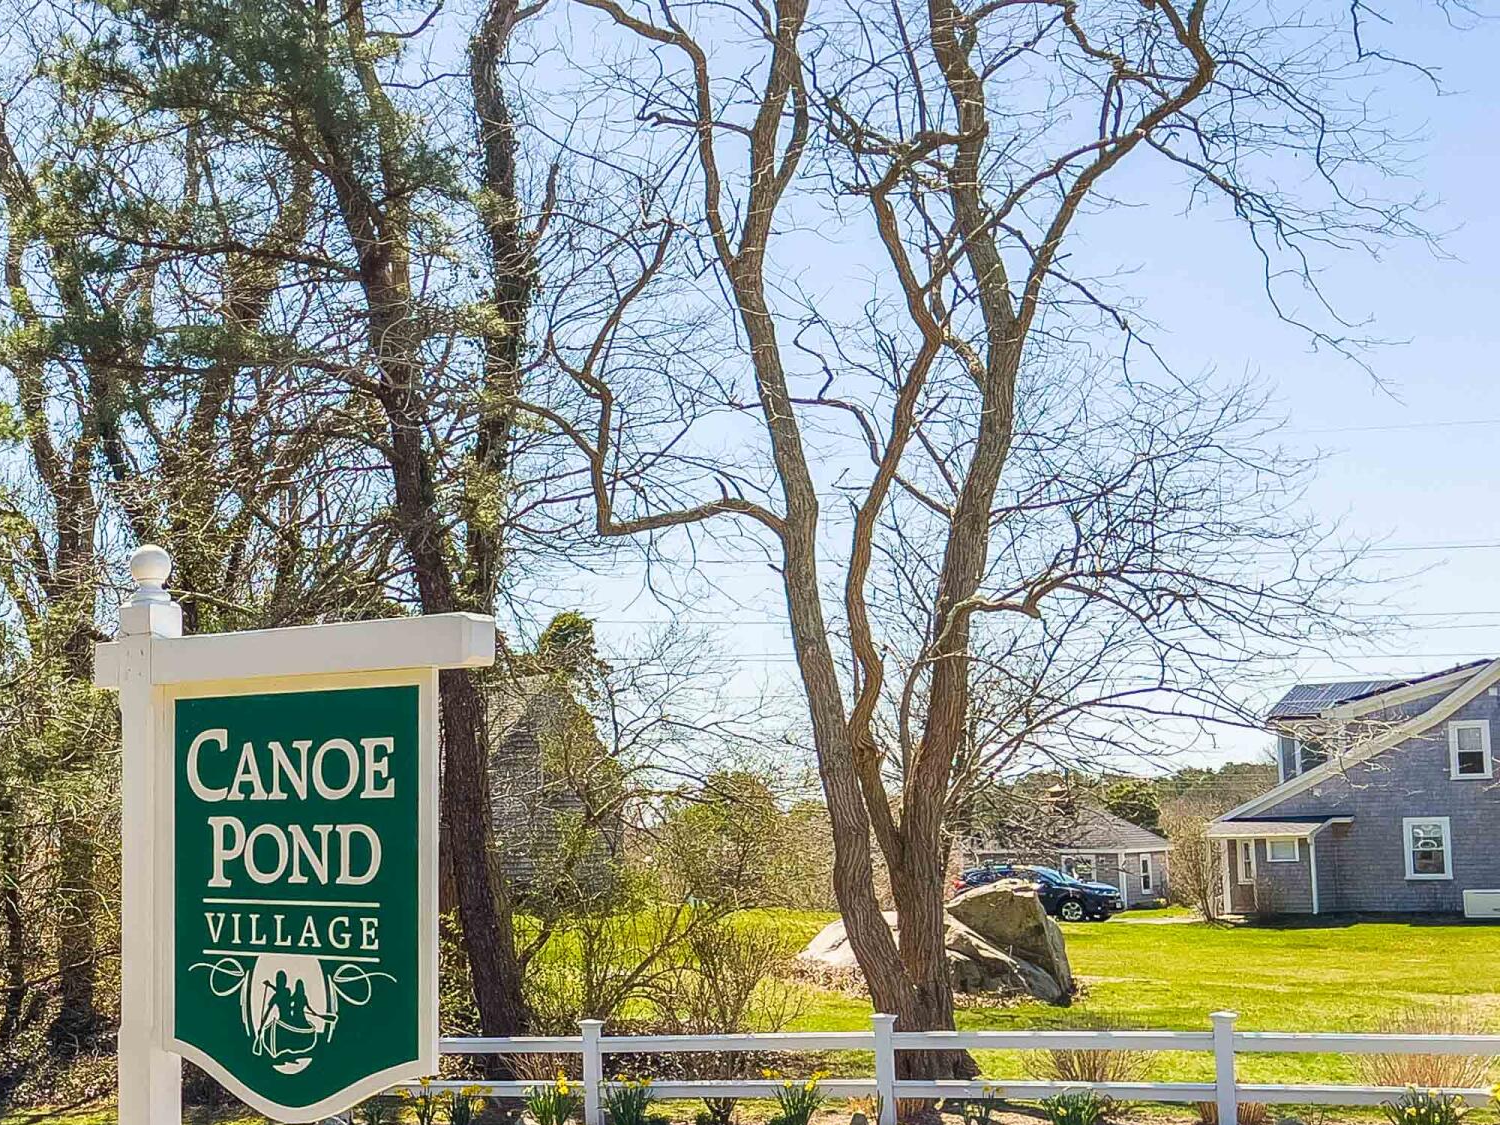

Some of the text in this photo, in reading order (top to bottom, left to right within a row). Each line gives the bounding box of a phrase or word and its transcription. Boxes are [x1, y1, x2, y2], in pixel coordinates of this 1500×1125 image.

[187, 728, 395, 802] CANOE
[207, 816, 382, 888] POND
[204, 912, 379, 950] VILLAGE
